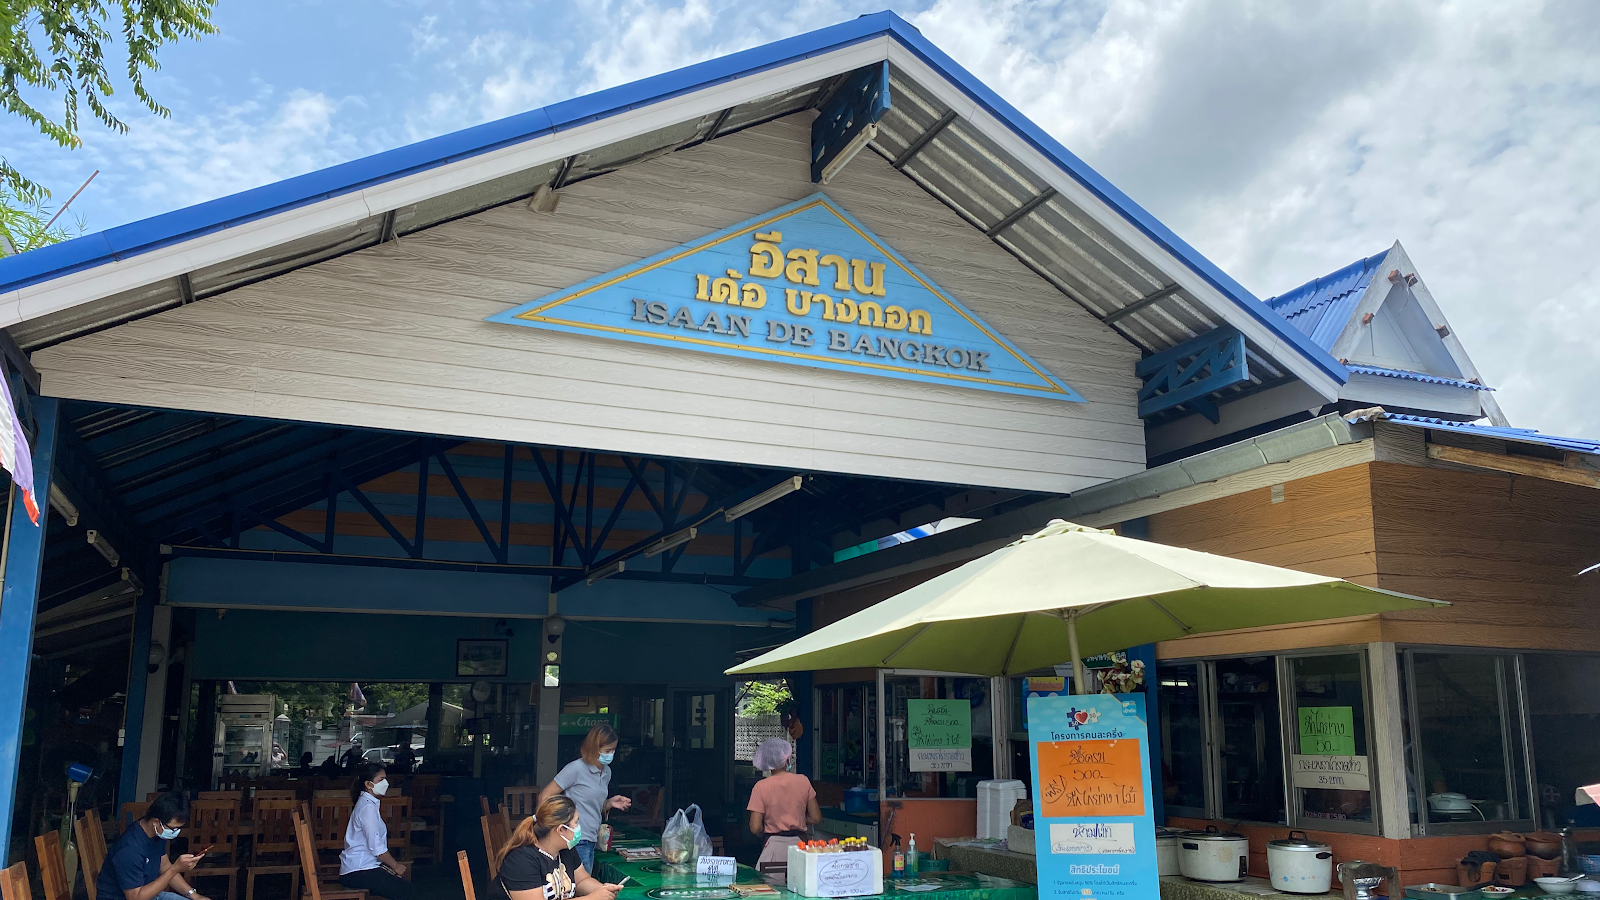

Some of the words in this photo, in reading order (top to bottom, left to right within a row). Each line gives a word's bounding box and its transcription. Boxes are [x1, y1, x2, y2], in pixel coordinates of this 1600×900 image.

[748, 231, 886, 297] อีสาน
[696, 270, 767, 310] เด้อ
[786, 288, 933, 336] บางกอก
[631, 298, 751, 338] ISAAN
[767, 319, 816, 348] DE
[829, 329, 992, 373] BANGKOK
[1051, 728, 1123, 740] โครงการคนละครึ่ง
[1318, 776, 1327, 784] 35
[1328, 776, 1344, 785] บาท
[1070, 864, 1120, 875] สิทธิประโยชน์
